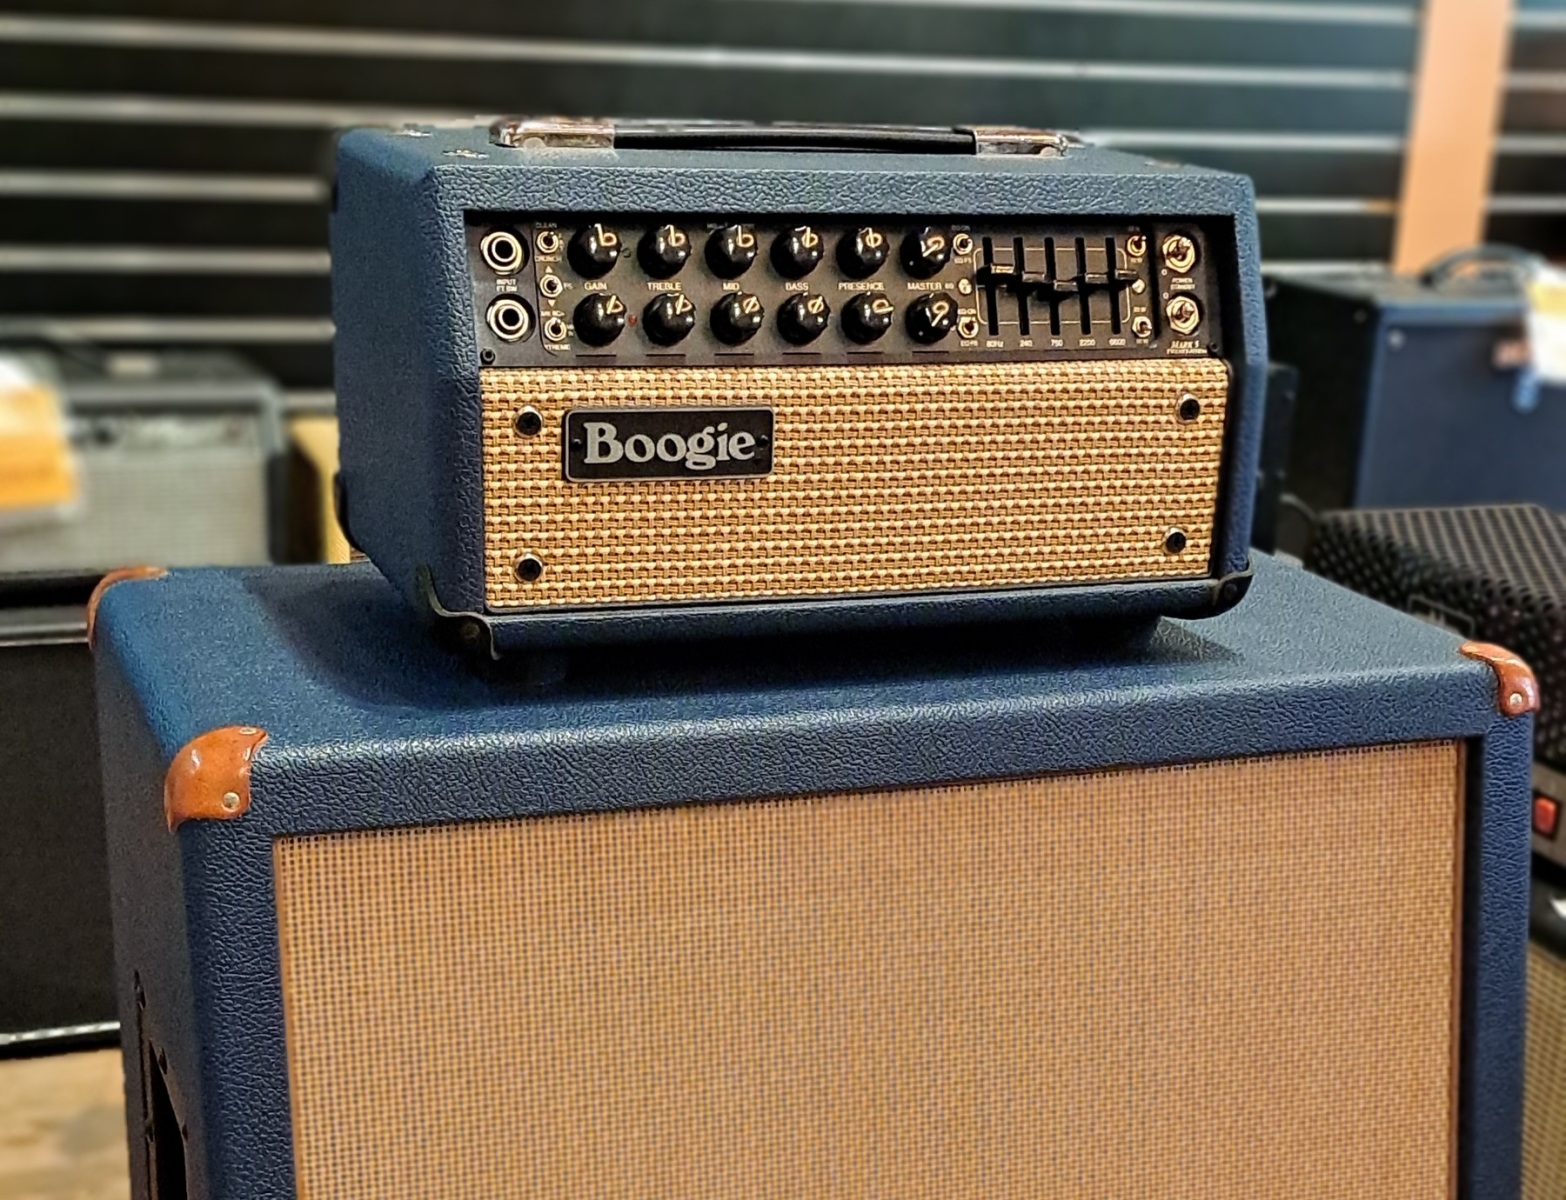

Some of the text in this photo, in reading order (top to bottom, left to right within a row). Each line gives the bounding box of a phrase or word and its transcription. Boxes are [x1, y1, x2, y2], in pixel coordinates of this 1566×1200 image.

[584, 282, 608, 291] GAIN
[647, 282, 682, 291] TREBLE
[722, 282, 740, 291] MID
[785, 282, 809, 291] BASS
[838, 281, 885, 291] PRESENCE
[907, 281, 942, 290] MASTER
[1170, 340, 1195, 349] MARK
[583, 422, 756, 471] Boogie
